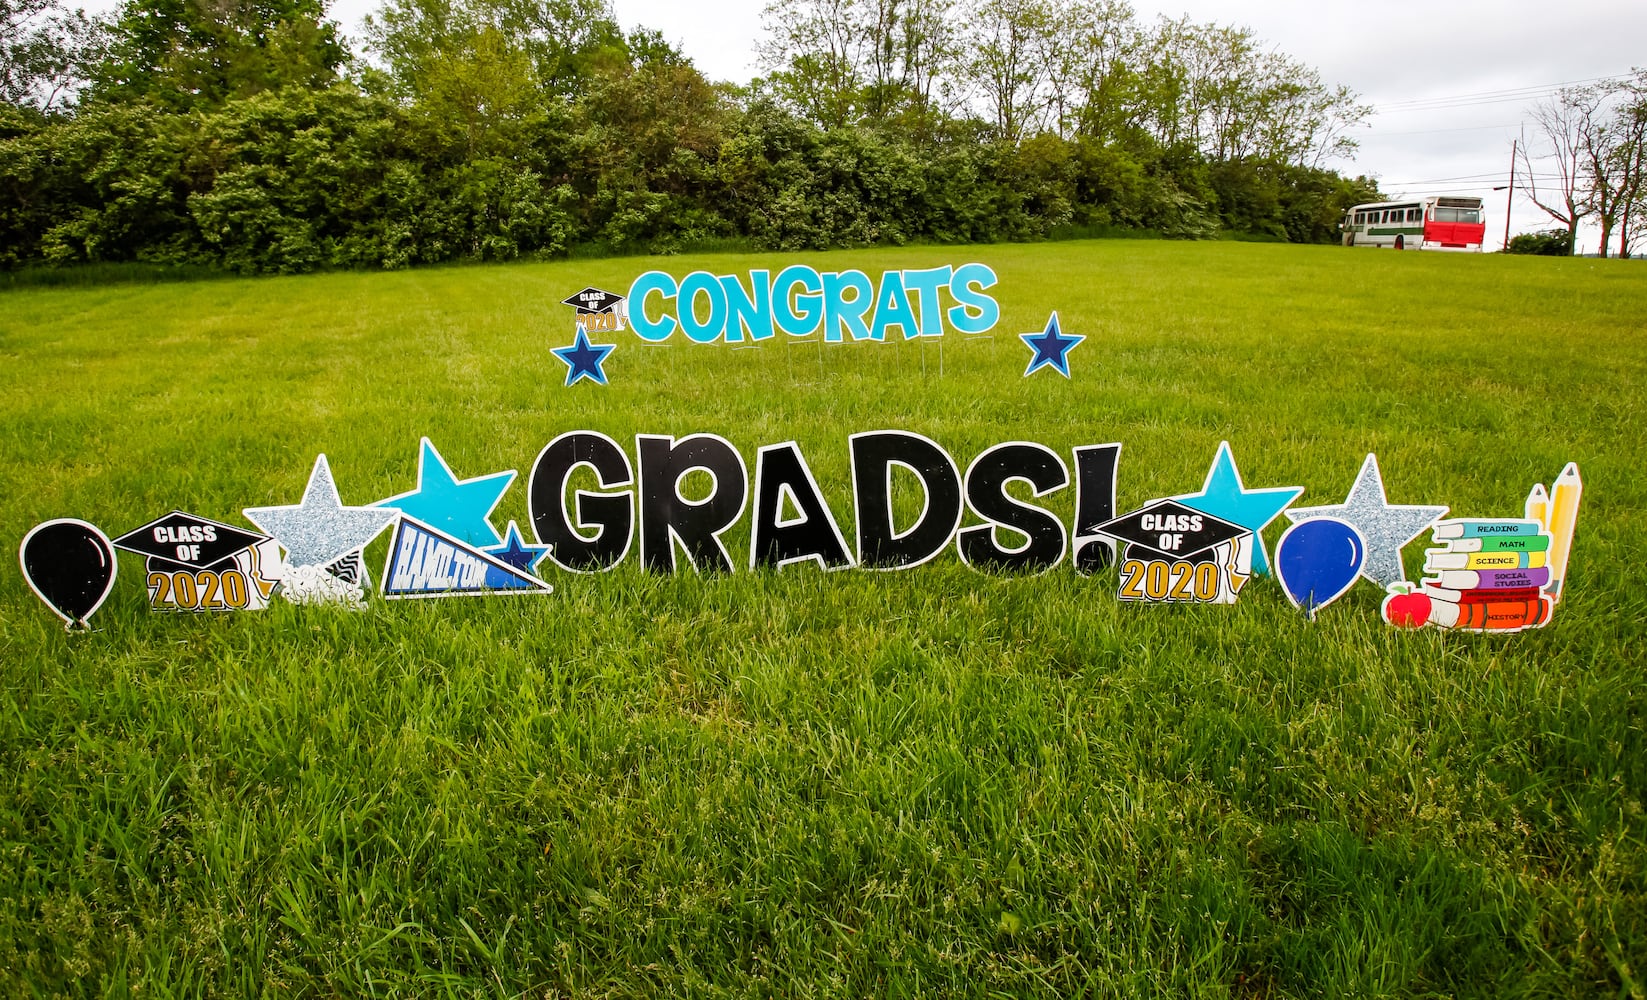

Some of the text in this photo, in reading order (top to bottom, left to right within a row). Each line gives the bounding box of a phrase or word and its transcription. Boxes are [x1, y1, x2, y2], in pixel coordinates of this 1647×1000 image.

[579, 292, 606, 302] CLASS
[588, 301, 599, 309] OF
[628, 263, 1000, 343] CONGRATS
[528, 429, 1122, 577] GRADS!
[1140, 514, 1203, 532] CLASS
[153, 526, 218, 543] CLASS
[1158, 533, 1184, 550] OF
[176, 544, 200, 561] OF
[390, 525, 488, 591] HAMILTON
[1119, 559, 1220, 601] 2020
[1494, 579, 1532, 587] STUDIES
[147, 570, 250, 610] 2020
